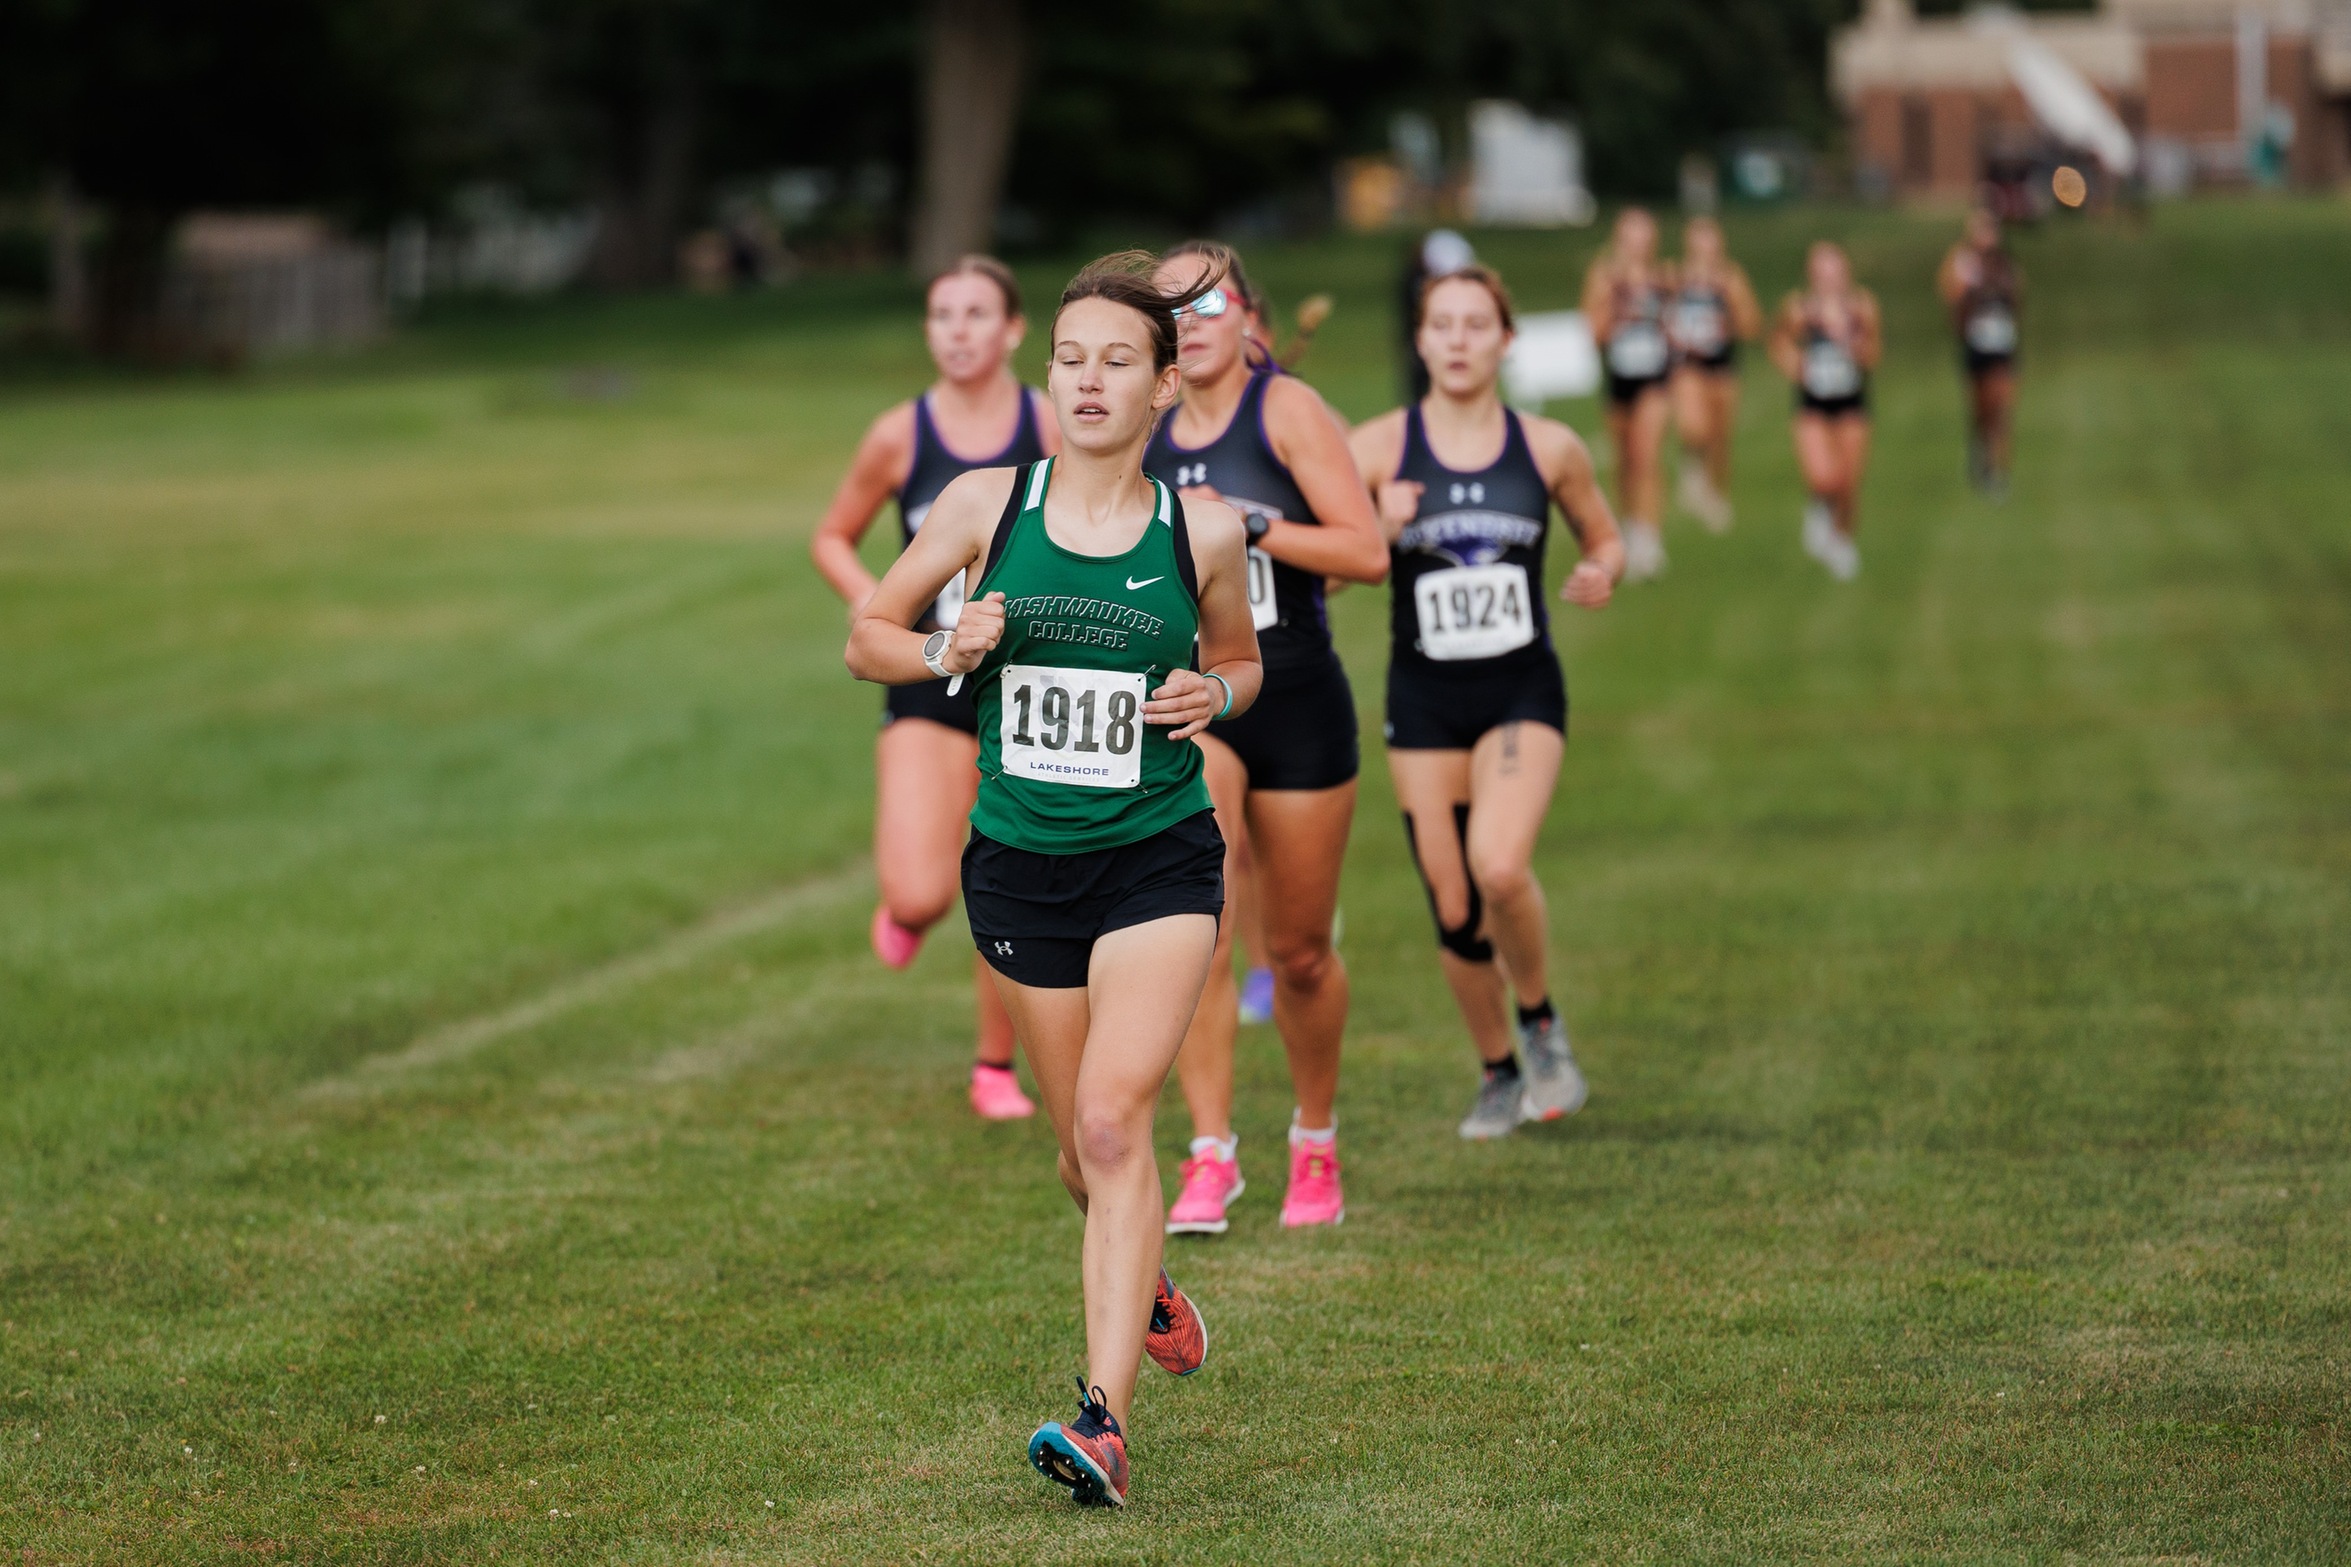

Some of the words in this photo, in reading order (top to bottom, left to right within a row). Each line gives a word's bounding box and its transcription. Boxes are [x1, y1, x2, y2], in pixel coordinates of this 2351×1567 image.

[1428, 583, 1522, 633] 1924
[1028, 619, 1130, 651] COLLEGE
[1012, 684, 1137, 755] 1918
[1030, 761, 1110, 777] LAKESHORE
